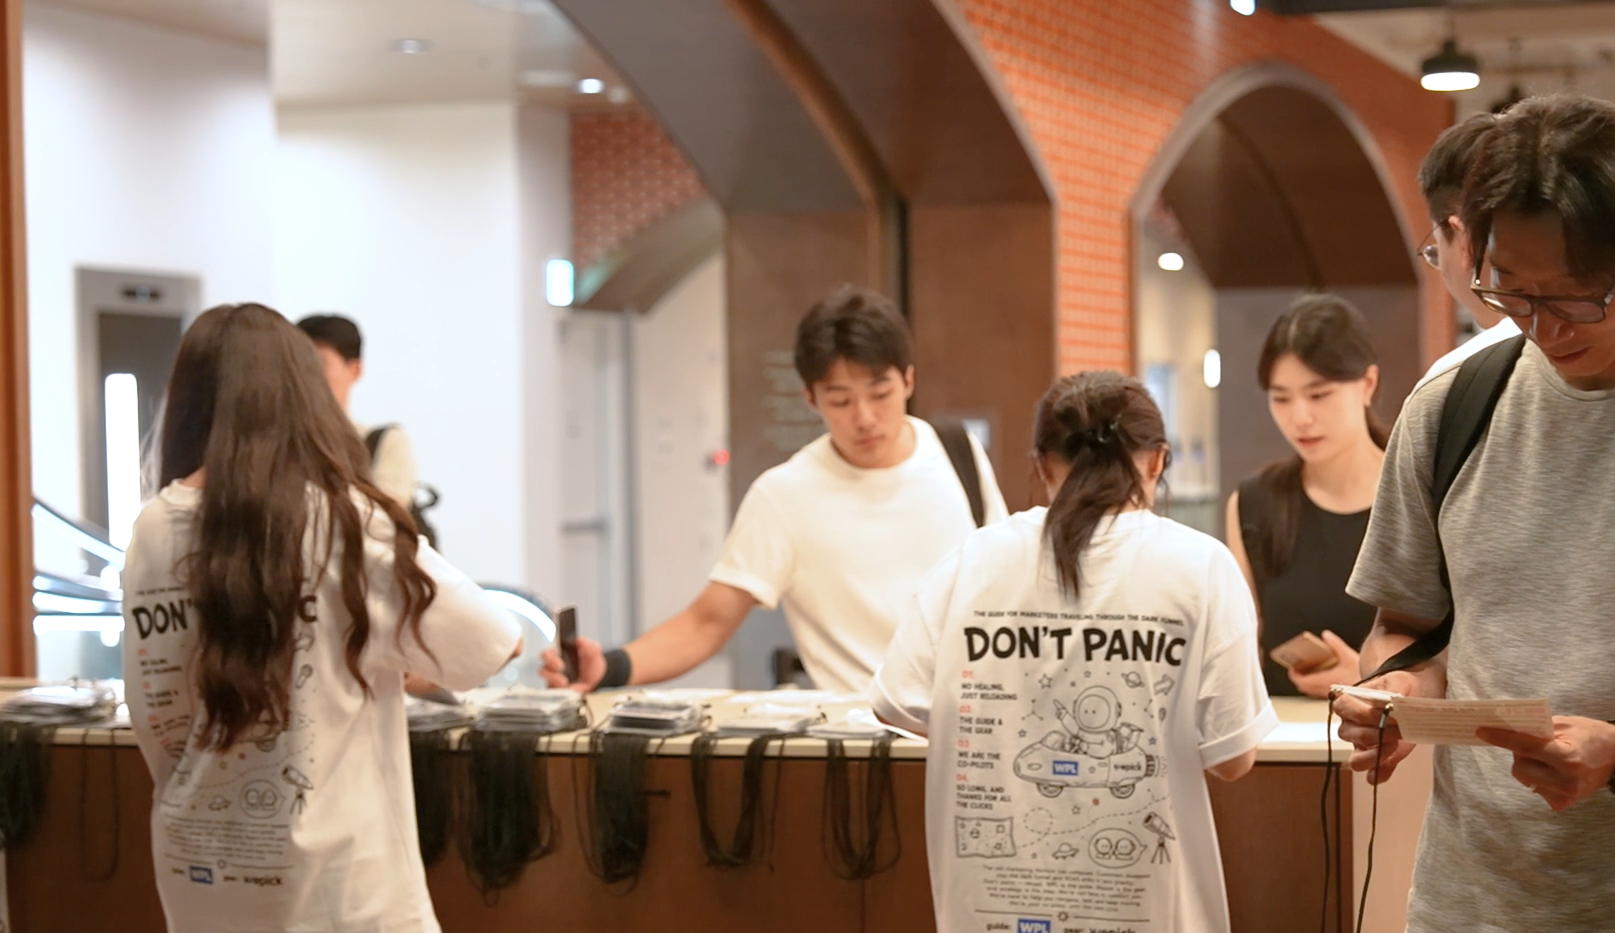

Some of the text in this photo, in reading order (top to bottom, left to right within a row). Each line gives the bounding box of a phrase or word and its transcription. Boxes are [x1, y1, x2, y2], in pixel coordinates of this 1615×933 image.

[973, 610, 986, 618] THE
[1127, 614, 1139, 622] THE
[963, 625, 1187, 667] DON'T PANIC
[959, 716, 973, 725] THE
[959, 725, 993, 735] THE GEAR
[971, 751, 985, 760] ARE
[987, 752, 1001, 761] THE
[1054, 763, 1077, 774] WPL
